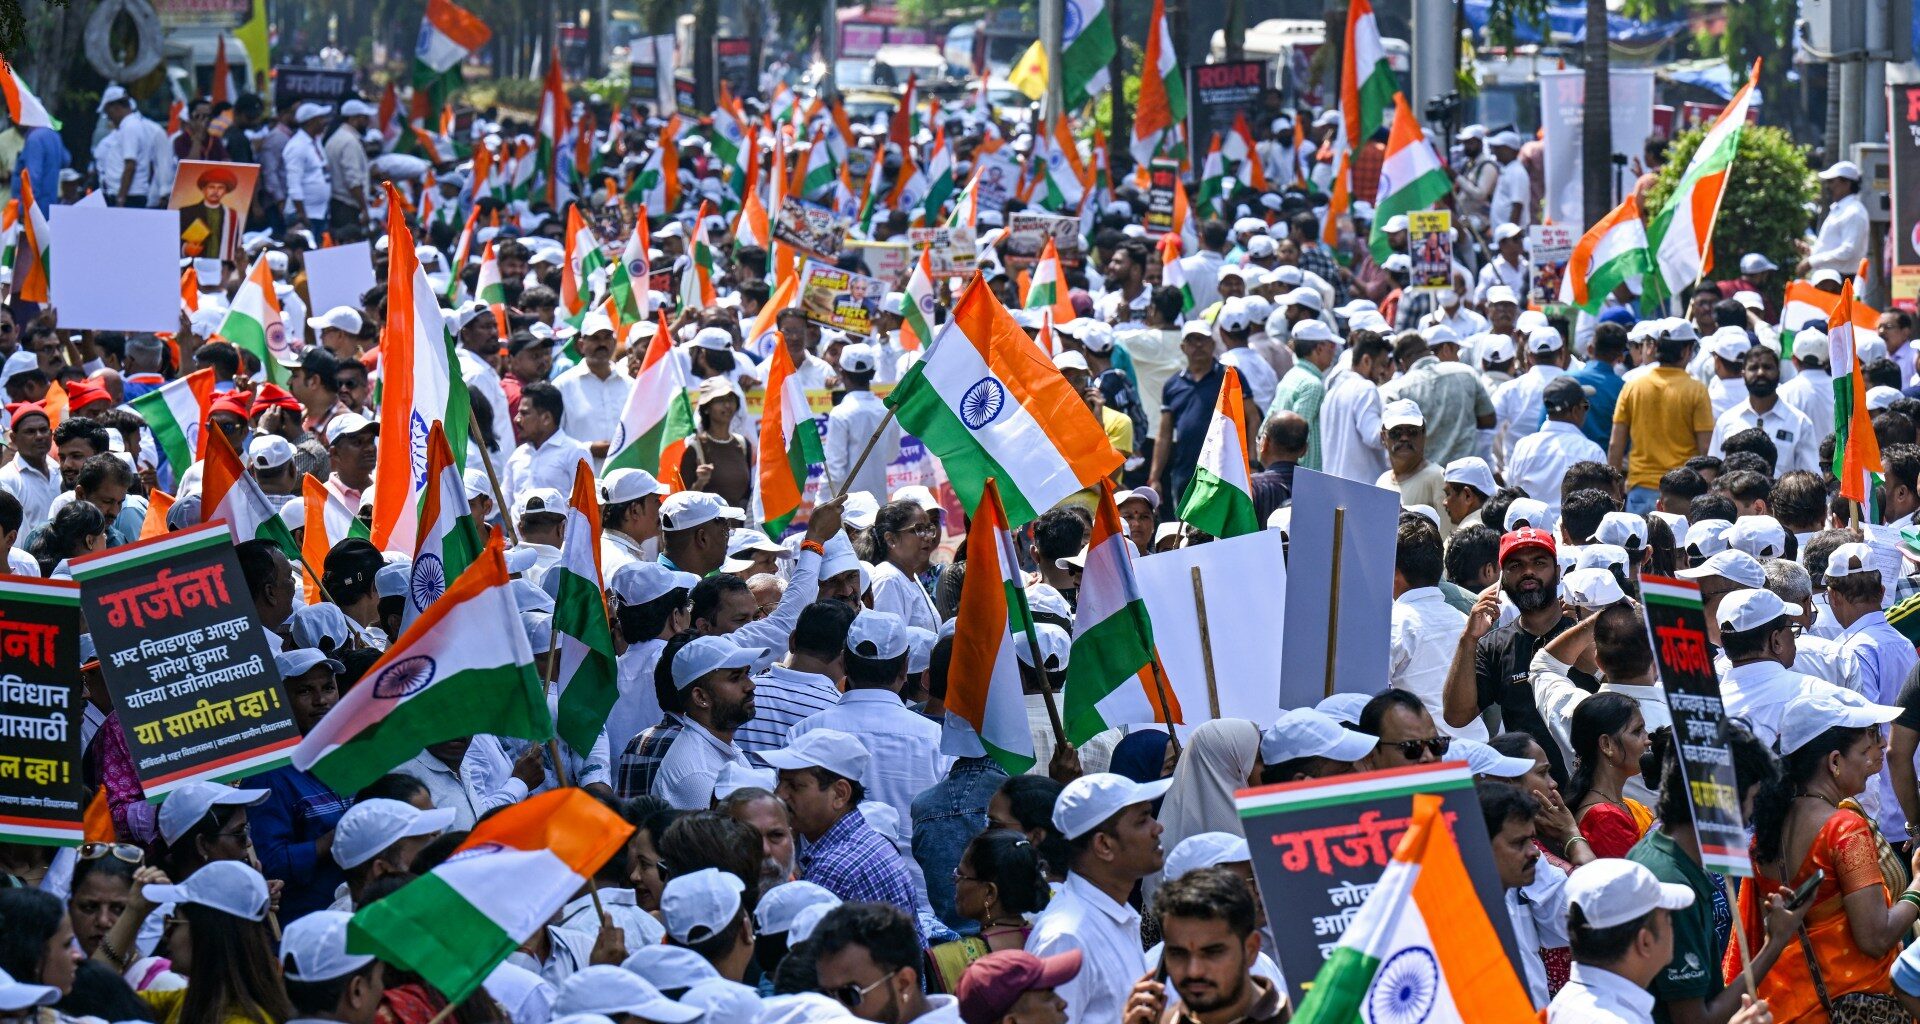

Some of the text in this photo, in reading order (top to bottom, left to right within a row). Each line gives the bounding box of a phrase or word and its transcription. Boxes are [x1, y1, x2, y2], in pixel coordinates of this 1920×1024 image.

[1198, 65, 1260, 89] ROAR
[99, 565, 231, 628] गर्जना
[111, 615, 250, 668] भ्रष्ट निवडणूक आयुक्त
[1657, 618, 1711, 676] गर्जना
[125, 654, 265, 710] यांच्या राजीनाम्यासाठी
[147, 644, 230, 683] ज्ञानेश कुमार
[1512, 671, 1527, 681] THE
[0, 674, 70, 708] विधान
[134, 720, 164, 746] या
[163, 694, 236, 738] सामील
[235, 689, 270, 719] व्हा
[181, 741, 214, 757] विधानसभा
[217, 733, 241, 747] कल्याण
[241, 726, 262, 741] ग्रामीण
[261, 718, 293, 734] विधानसभा
[24, 758, 59, 785] व्हा
